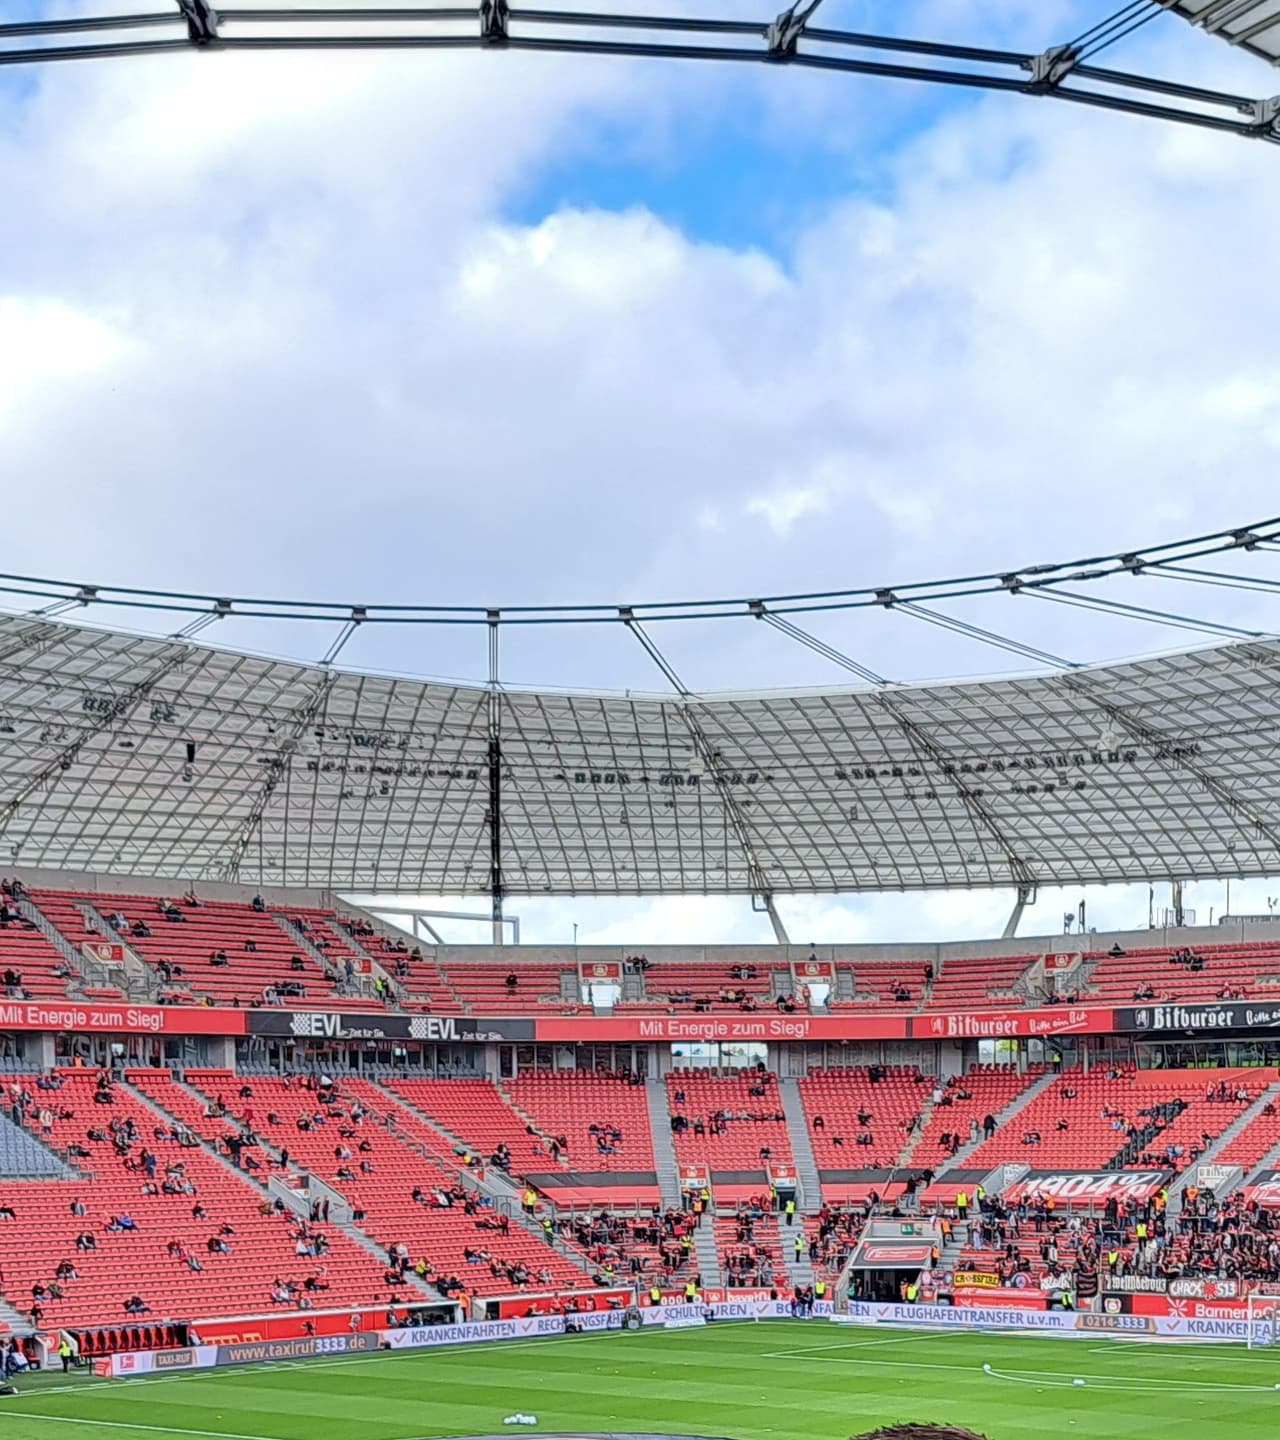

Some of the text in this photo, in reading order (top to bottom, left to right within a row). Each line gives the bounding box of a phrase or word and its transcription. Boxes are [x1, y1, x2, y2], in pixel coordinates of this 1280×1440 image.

[27, 1006, 87, 1029] Energie
[89, 1011, 124, 1026] zum
[126, 1009, 165, 1032] Sieg!
[310, 1013, 342, 1038] EVL
[426, 1018, 461, 1040] EVL
[639, 1020, 810, 1039] Mit Energie zum Sieg!
[947, 1015, 1019, 1036] Bitburger
[1153, 1008, 1234, 1029] Bitburger
[411, 1322, 516, 1344] KRANKENFAHRTEN
[894, 1306, 1024, 1326] FLUGHAFENTRANSFER
[229, 1334, 366, 1361] www.taxiruf3333.de
